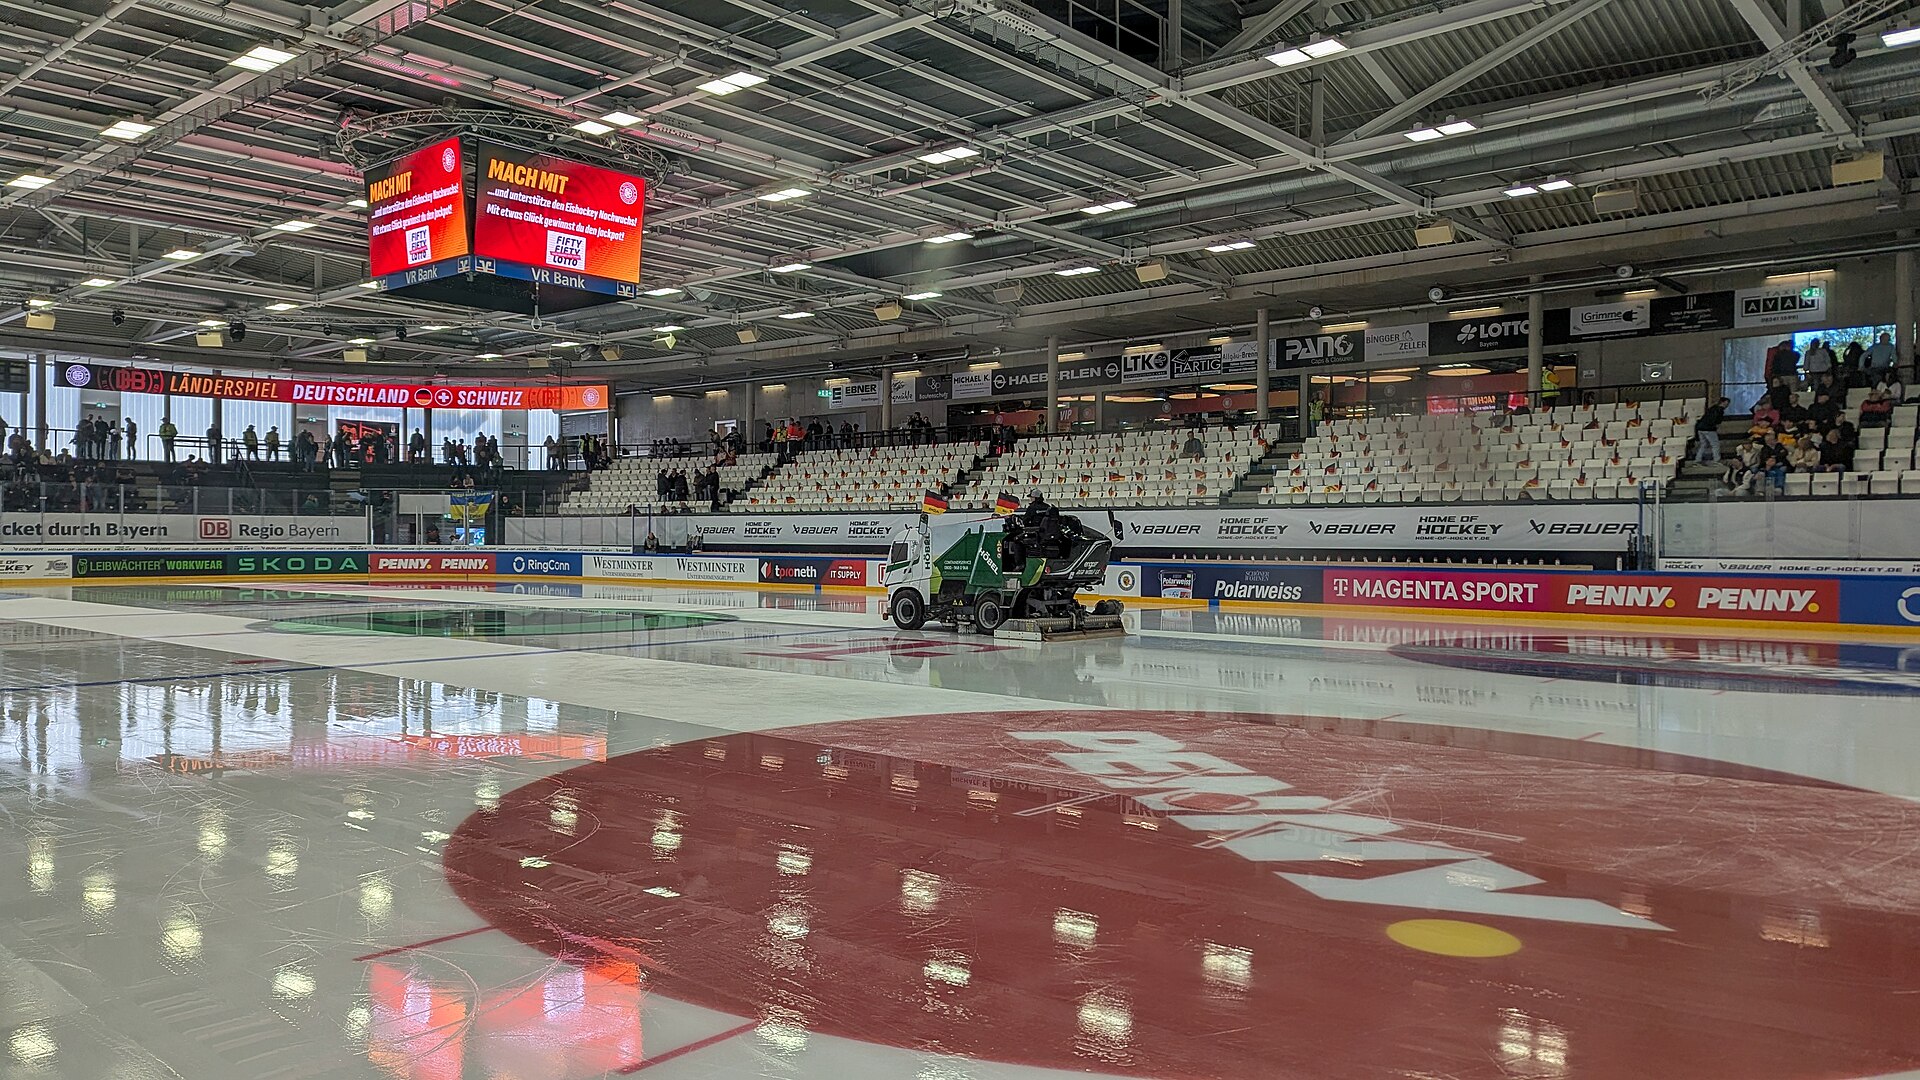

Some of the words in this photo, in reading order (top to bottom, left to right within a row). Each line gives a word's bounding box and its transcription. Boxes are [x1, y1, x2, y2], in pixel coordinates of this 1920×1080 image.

[488, 159, 537, 188] MACH
[539, 171, 569, 194] MIT
[370, 176, 395, 203] MACH
[396, 171, 412, 196] MIT
[509, 191, 551, 207] unterstütze
[552, 199, 564, 211] den
[565, 202, 598, 220] Eishockey
[599, 210, 638, 227] Nachwuchs!
[486, 204, 500, 216] Mit
[500, 208, 523, 220] etwas
[524, 212, 543, 225] Glück
[544, 217, 575, 231] gewinnst
[575, 224, 584, 233] du
[585, 225, 597, 236] den
[411, 229, 426, 242] FIFTY
[556, 236, 582, 248] FIFTY
[411, 240, 426, 250] FIFTY
[555, 245, 581, 256] FIFTY
[553, 255, 578, 267] LOTTO
[405, 270, 417, 284] VR
[418, 267, 437, 281] Bank
[531, 267, 550, 283] VR
[553, 271, 585, 289] Bank
[1583, 311, 1623, 322] Grimme
[1399, 340, 1427, 350] ZELLER
[1123, 354, 1154, 372] LTK
[1174, 359, 1221, 373] HARTIG
[953, 374, 983, 384] MICHAEL
[1009, 366, 1101, 386] HAEBRLEN
[169, 373, 279, 398] LÄNDERSPIEL
[845, 384, 877, 394] EBNER
[292, 384, 410, 404] DEUTSCHLAND
[457, 390, 522, 406] SCHWEIZ
[1059, 409, 1072, 421] VIP
[1419, 515, 1456, 523] HOME
[48, 522, 101, 536] durch
[106, 522, 168, 542] Bayern
[203, 521, 228, 536] DB
[239, 523, 284, 540] Regio
[288, 524, 339, 539] Bayern
[848, 526, 892, 535] HOCKEY
[1218, 525, 1288, 535] HOCKEY
[1416, 524, 1503, 535] HOCKEY
[923, 533, 931, 570] HÖBEL
[166, 560, 223, 570] WORKWEAR
[527, 560, 570, 573] RingConn
[593, 556, 653, 571] WESTMINSTER
[677, 558, 745, 573] WESTMINSTER
[979, 547, 999, 576] HÖBEL
[775, 565, 817, 579] tproneth
[831, 570, 837, 578] IT
[837, 570, 861, 579] SUPPLY
[1779, 565, 1903, 573] HOME-OF-HOCKEY.DE
[1162, 577, 1191, 586] Polarweiss
[1214, 580, 1302, 600] Polarweiss
[1353, 579, 1459, 602] MAGENTA
[1461, 581, 1538, 604] SPORT
